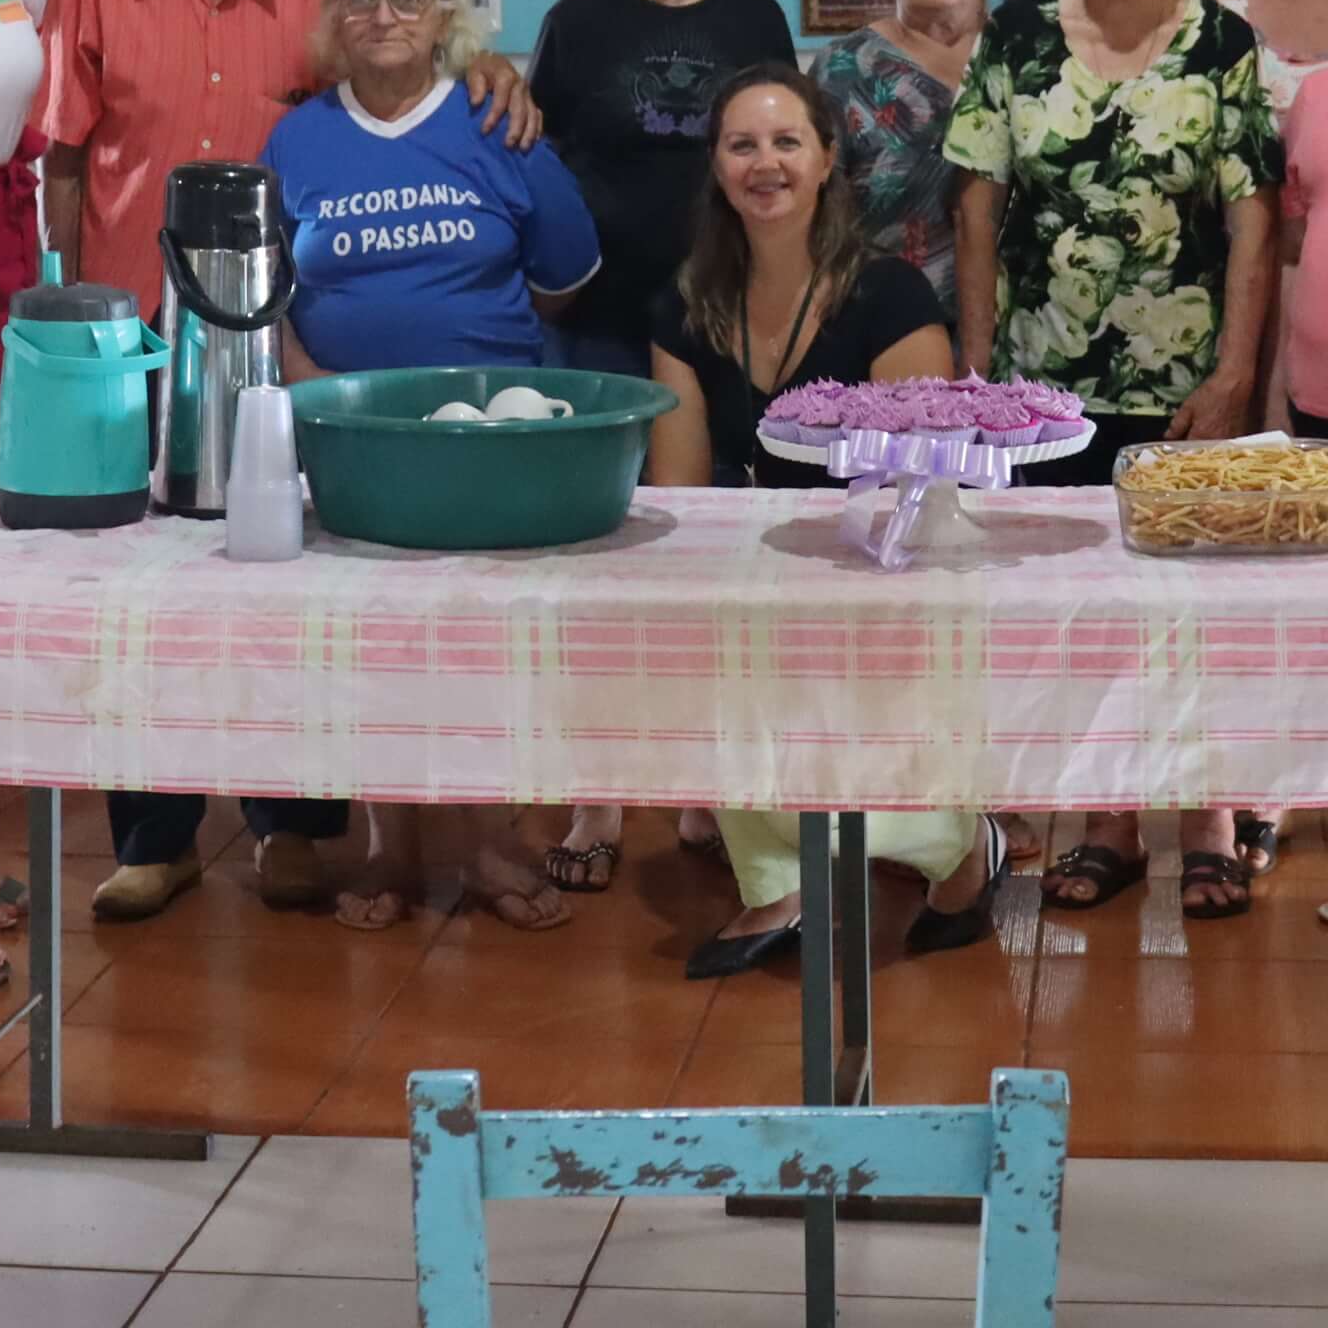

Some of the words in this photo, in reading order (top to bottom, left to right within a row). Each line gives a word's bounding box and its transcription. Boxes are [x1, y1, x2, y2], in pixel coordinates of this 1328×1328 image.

[319, 184, 481, 219] RECORDANDO
[333, 233, 352, 256] O
[362, 219, 475, 254] PASSADO
